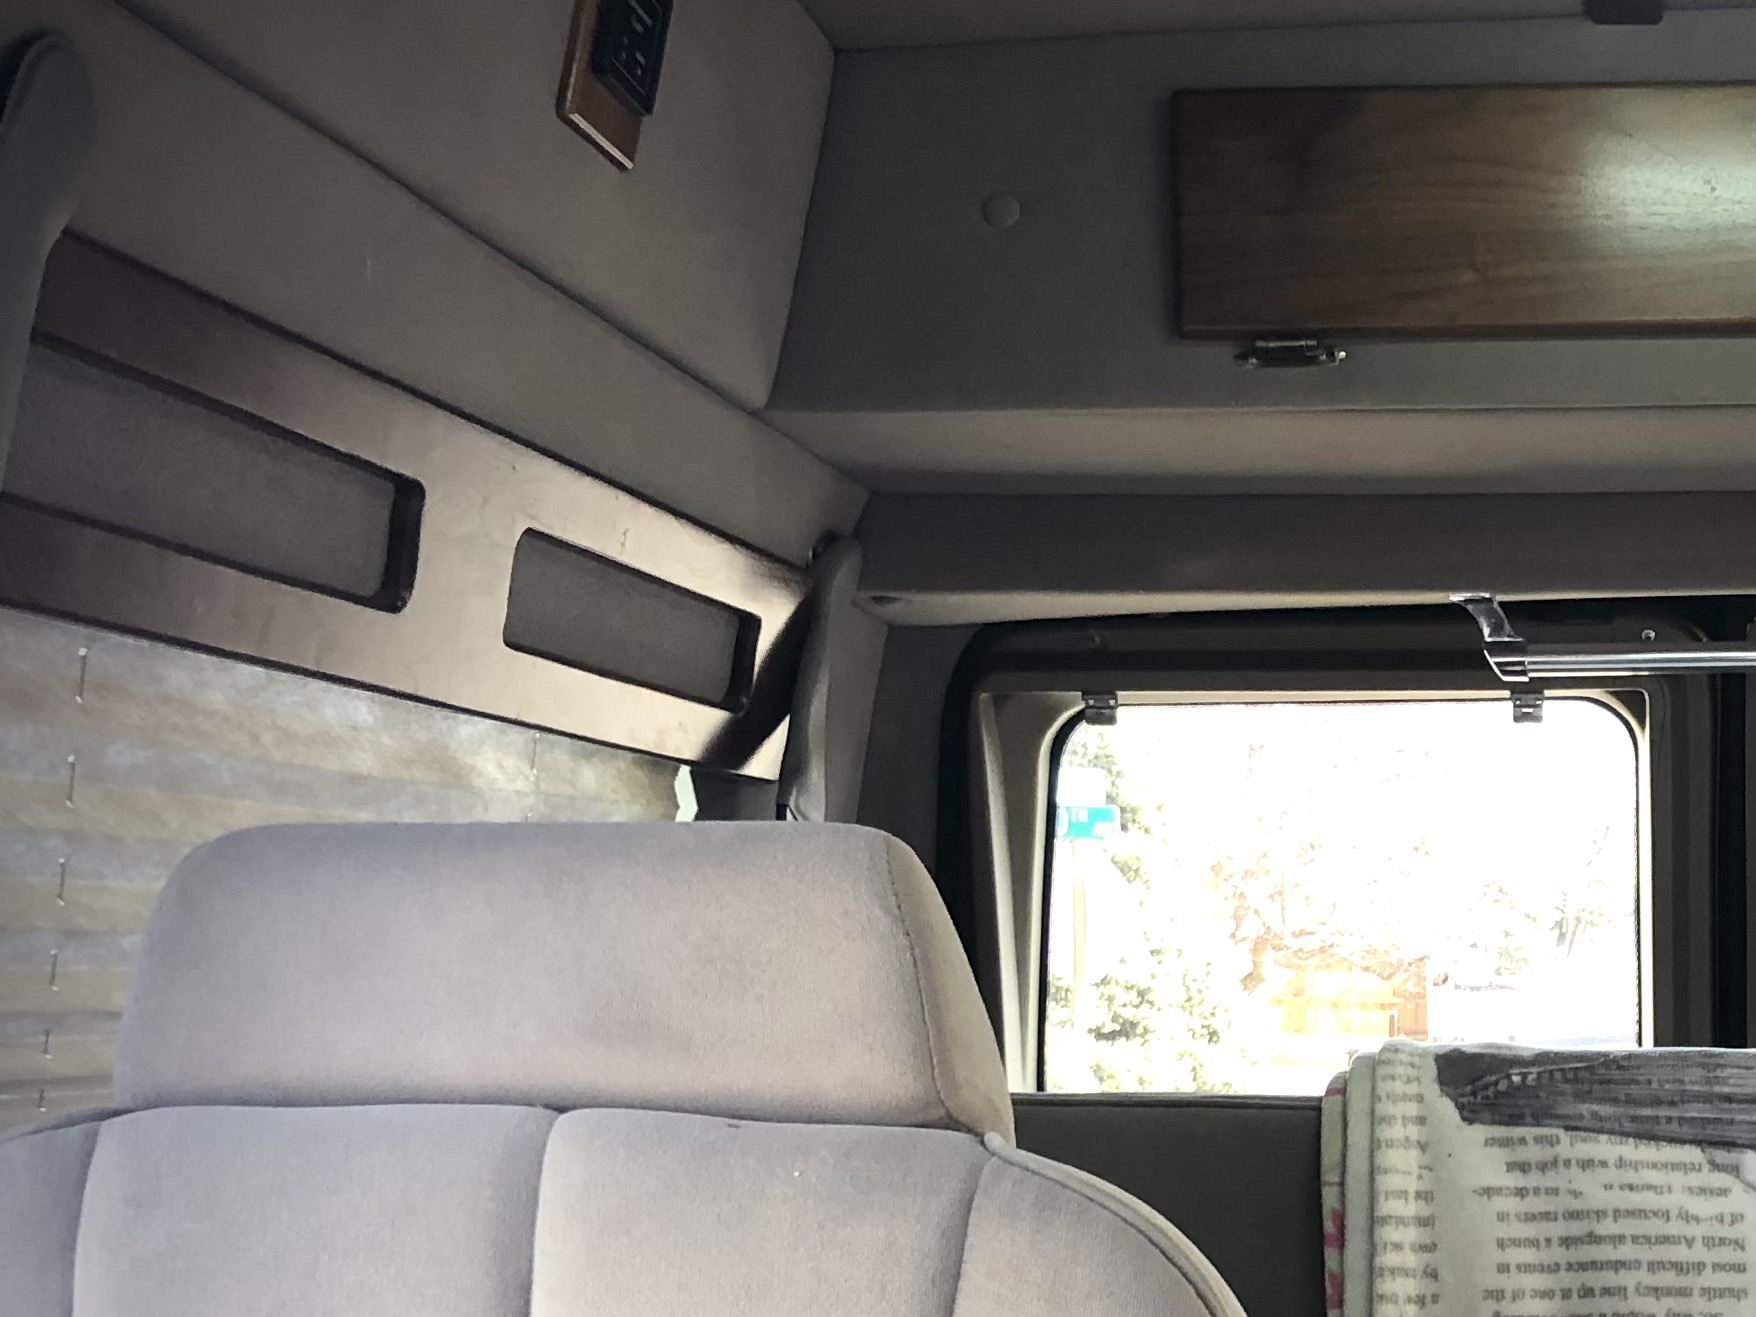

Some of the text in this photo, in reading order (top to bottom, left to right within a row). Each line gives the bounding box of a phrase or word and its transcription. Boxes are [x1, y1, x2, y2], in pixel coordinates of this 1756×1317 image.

[1482, 1134, 1529, 1150] winter
[1531, 1134, 1563, 1150] this
[1504, 1160, 1533, 1177] that
[1534, 1156, 1559, 1176] job
[1562, 1158, 1572, 1171] a
[1574, 1157, 1608, 1173] with
[1612, 1154, 1703, 1174] relationship
[1414, 1189, 1435, 1204] the
[1470, 1184, 1530, 1202] decade-
[1532, 1186, 1542, 1198] a
[1495, 1210, 1511, 1226] in
[1561, 1207, 1609, 1225] skimo
[1612, 1208, 1671, 1225] focused
[1727, 1211, 1745, 1227] of
[1495, 1230, 1747, 1254] North America alongside a bunch
[1420, 1263, 1440, 1284] by
[1495, 1258, 1748, 1279] most difficult endurance events in
[1405, 1293, 1427, 1311] few
[1431, 1293, 1440, 1306] a
[1481, 1282, 1749, 1305] shuttle monkey line up at one of the
